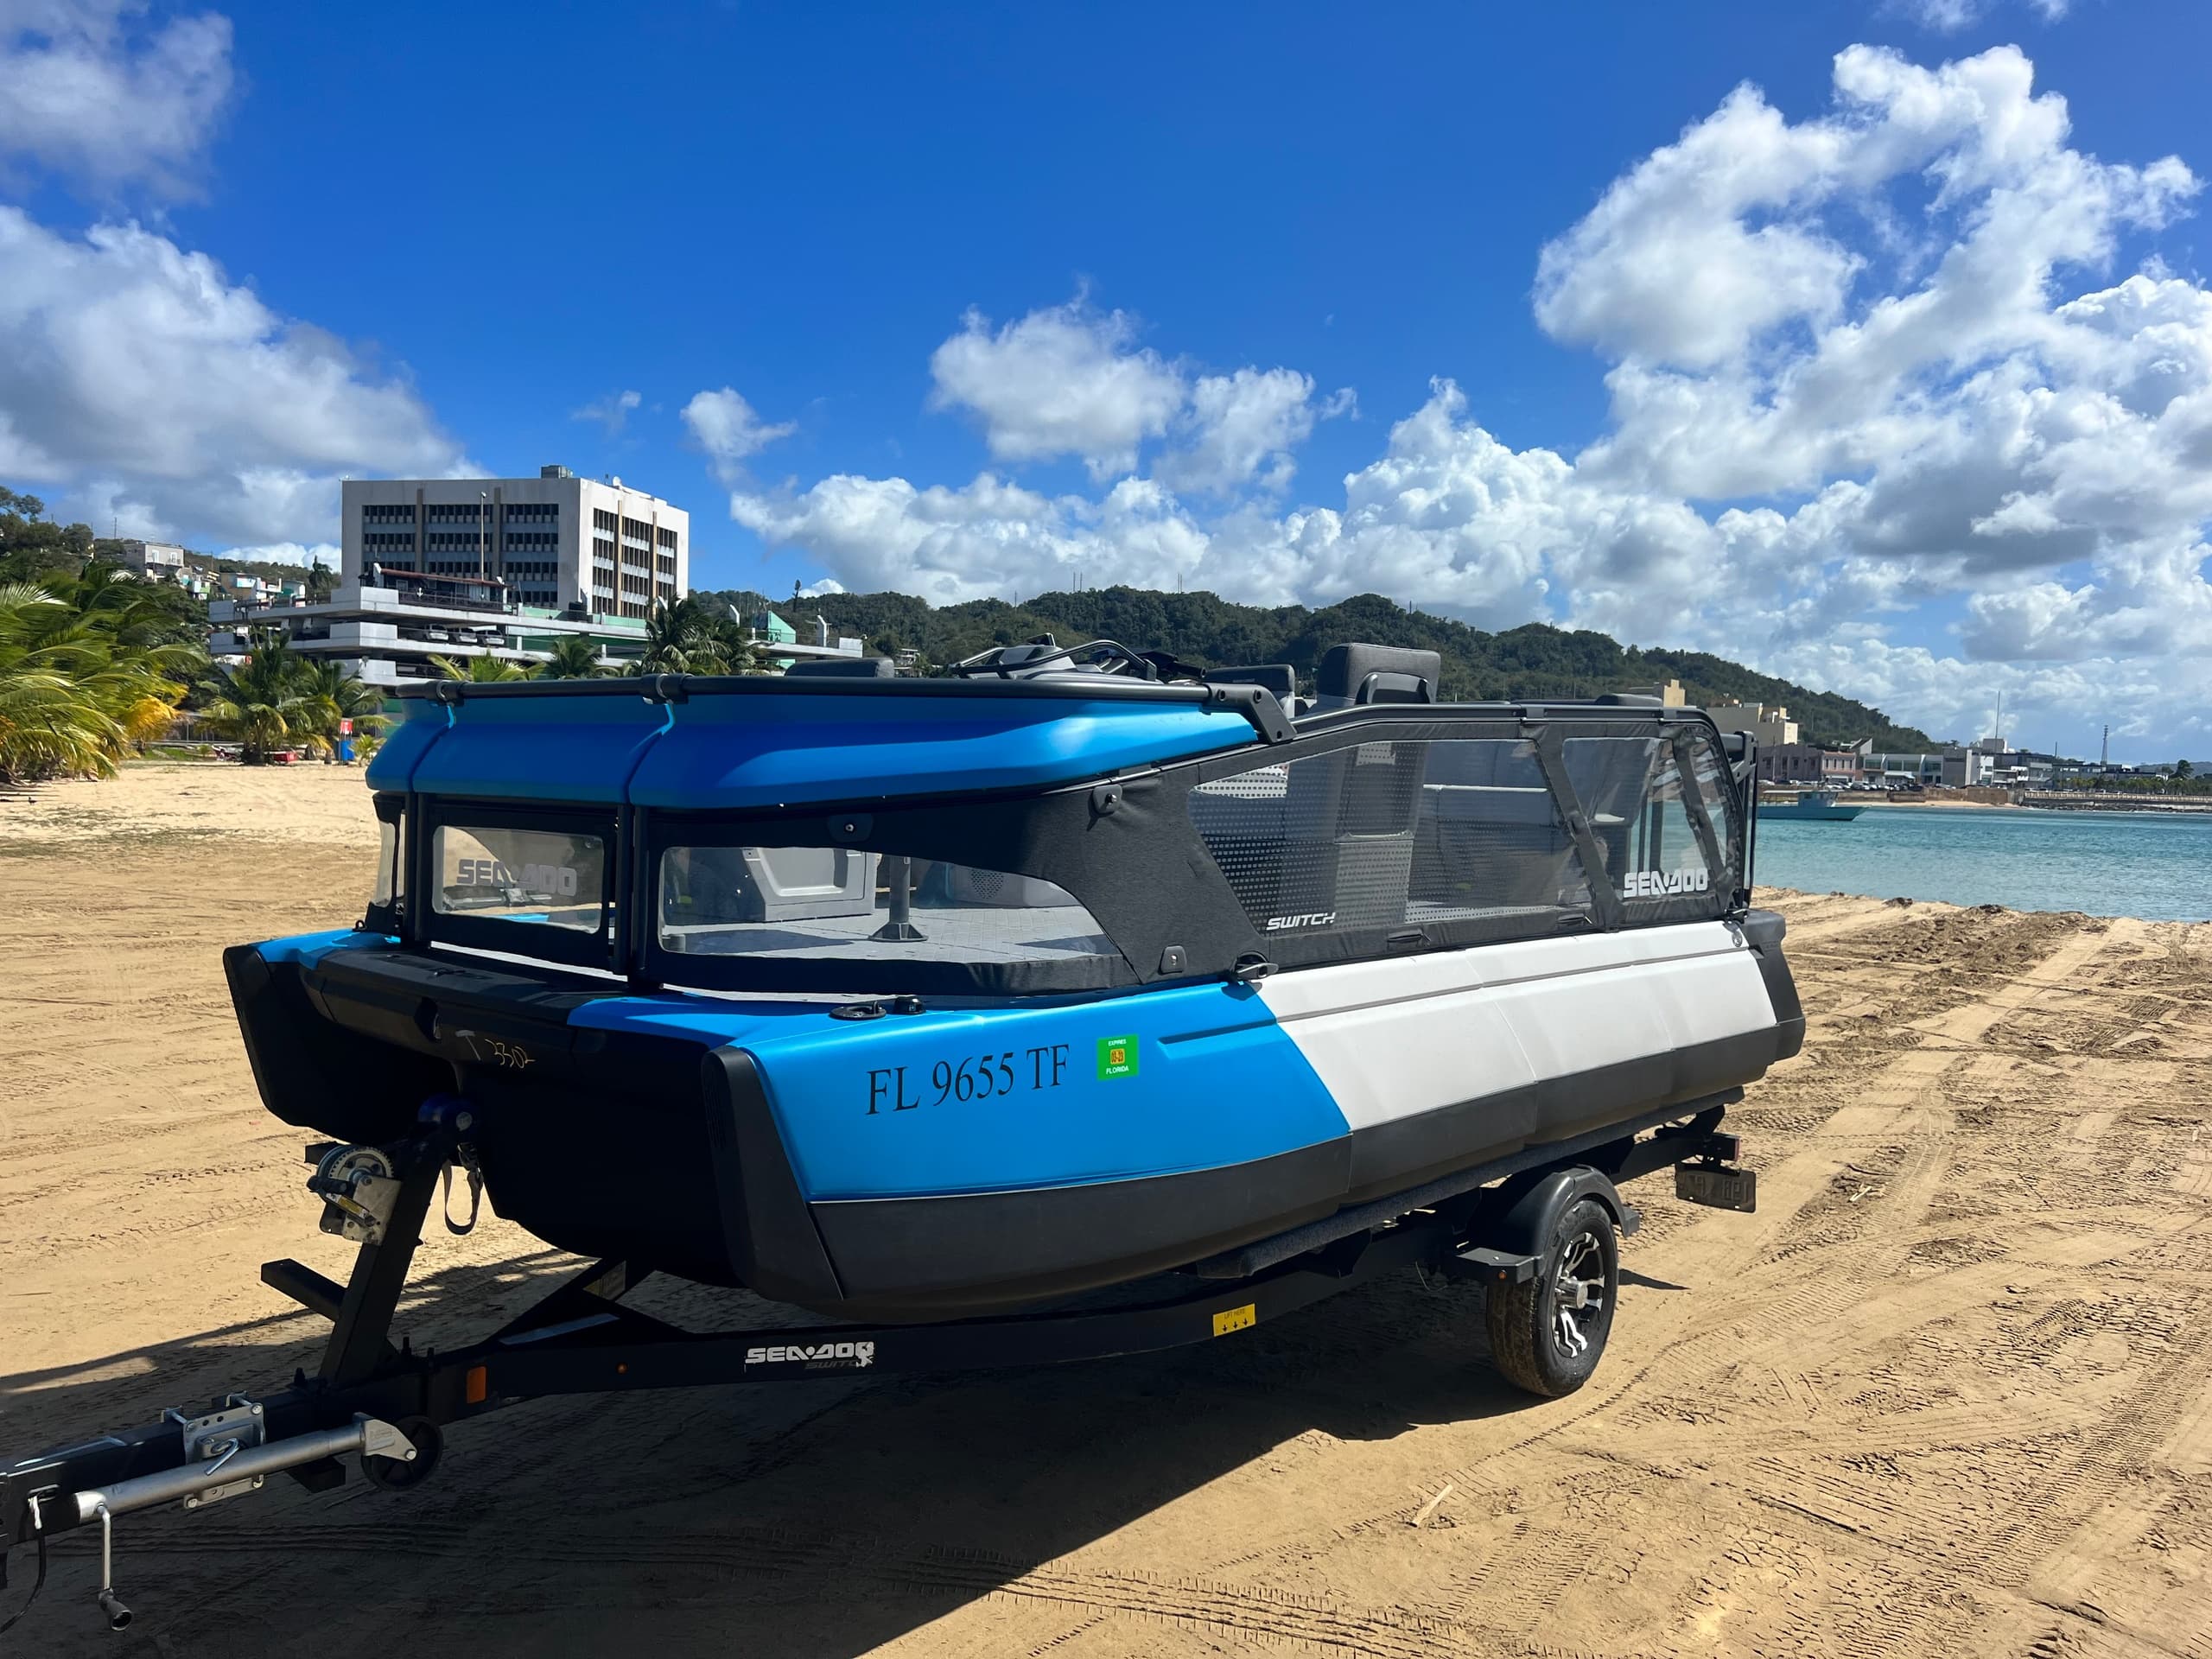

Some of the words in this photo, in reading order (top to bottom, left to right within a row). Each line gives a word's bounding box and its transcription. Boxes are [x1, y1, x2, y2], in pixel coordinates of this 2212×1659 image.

[1266, 912, 1336, 931] SWITCH
[1106, 1065, 1129, 1075] FLORIDA
[864, 1065, 920, 1116] FL
[932, 1052, 1014, 1107] 9655
[1026, 1044, 1070, 1090] TF
